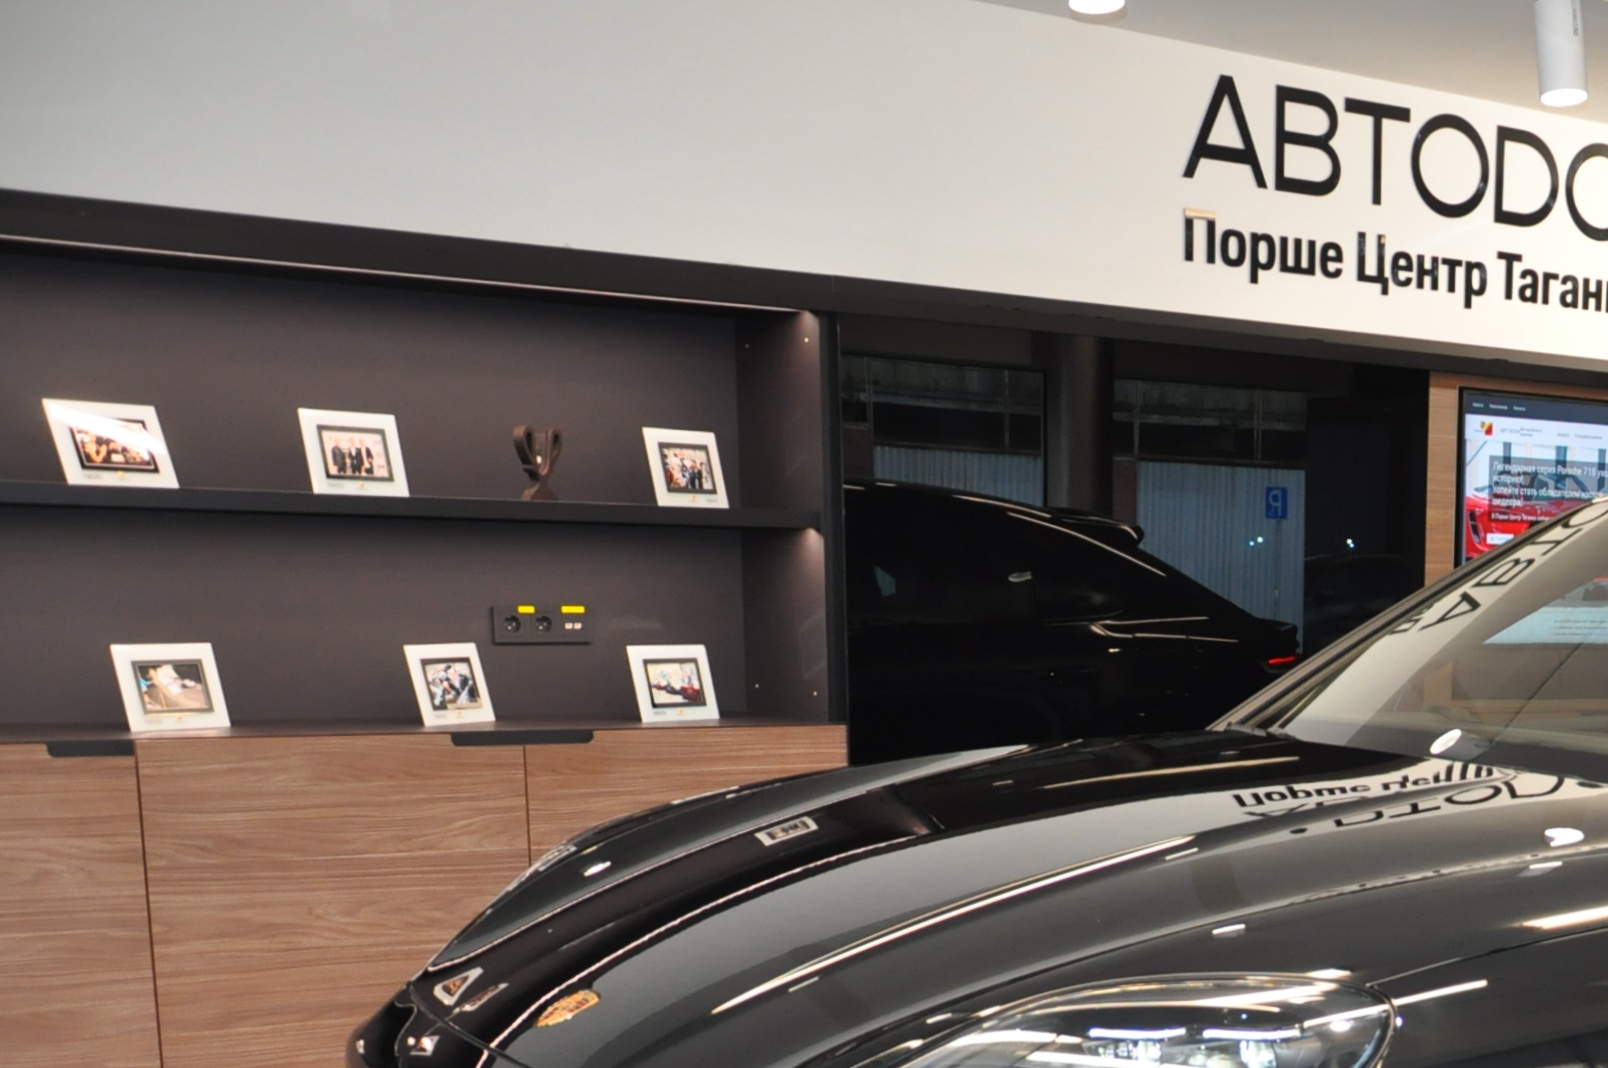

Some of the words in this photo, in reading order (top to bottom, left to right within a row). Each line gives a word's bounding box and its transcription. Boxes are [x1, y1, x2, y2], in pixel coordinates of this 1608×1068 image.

[1183, 207, 1343, 284] Порше
[1356, 231, 1487, 309] Центр
[1557, 465, 1582, 476] Porsche
[1583, 467, 1596, 477] 718
[1519, 488, 1538, 497] стать
